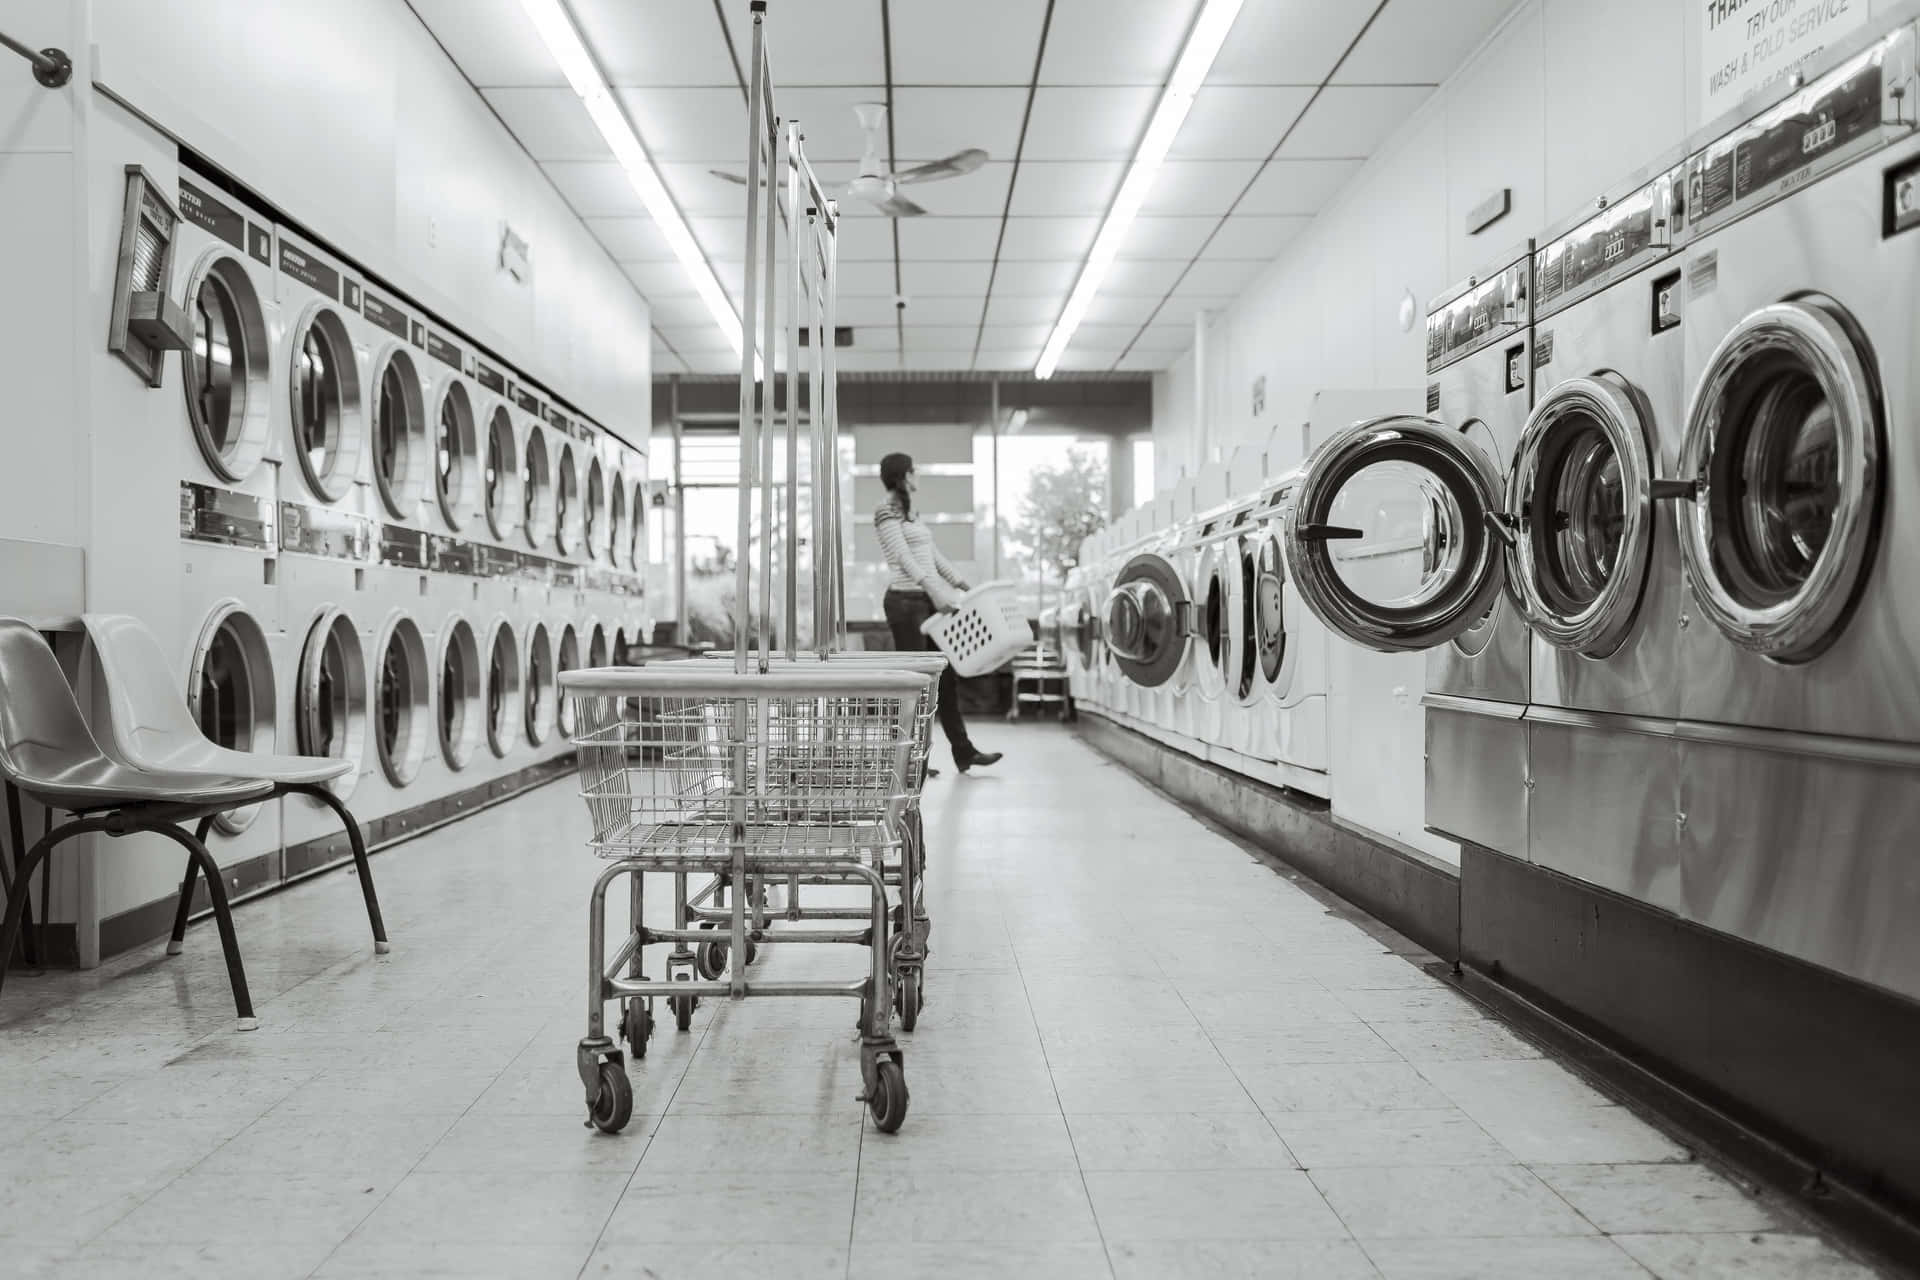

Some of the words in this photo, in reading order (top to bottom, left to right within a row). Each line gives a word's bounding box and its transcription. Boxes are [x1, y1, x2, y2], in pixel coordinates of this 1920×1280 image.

[1709, 57, 1738, 96] WASH
[1741, 51, 1749, 75] &
[1752, 26, 1785, 66] FOLD
[1788, 0, 1849, 44] SERVICE
[1747, 8, 1768, 40] TRY
